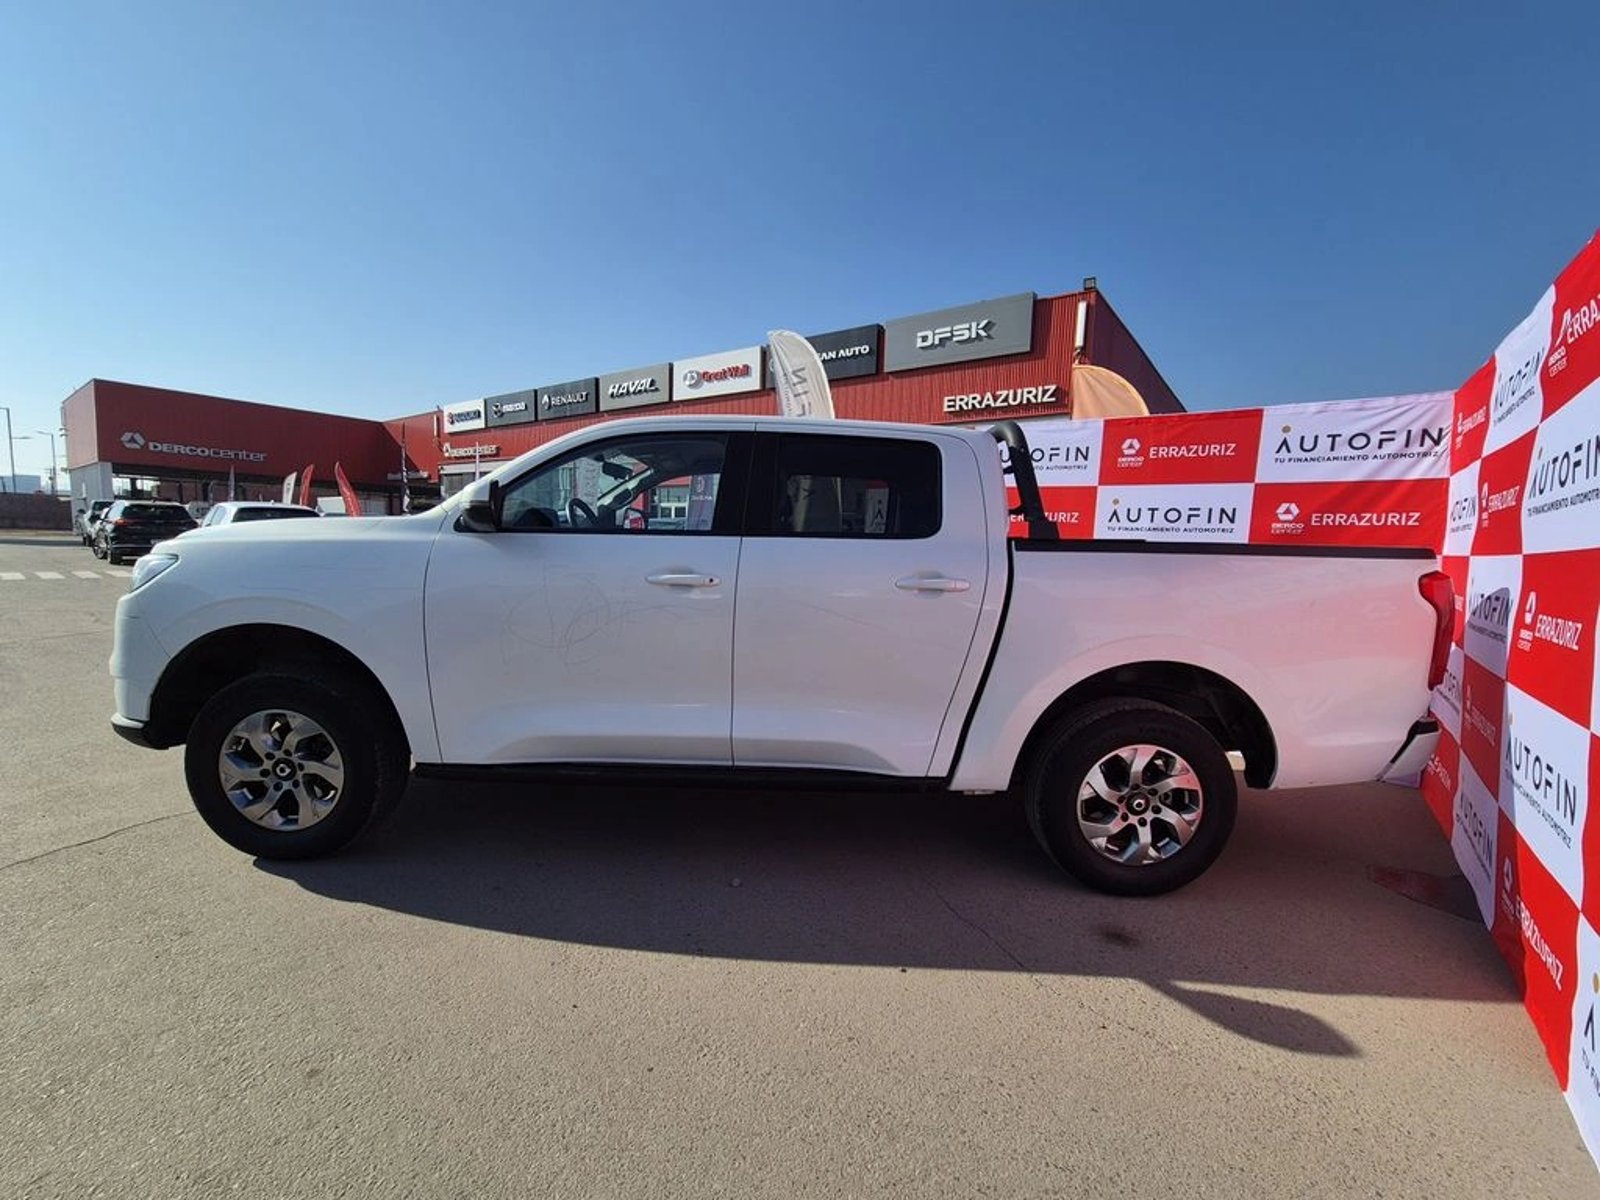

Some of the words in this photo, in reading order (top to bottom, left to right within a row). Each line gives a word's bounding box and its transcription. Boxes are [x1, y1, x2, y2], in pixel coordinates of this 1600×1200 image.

[916, 320, 990, 347] DFSK
[838, 345, 870, 357] AUTO
[608, 378, 656, 397] HAVAL
[551, 391, 588, 406] RENAULT
[943, 385, 1057, 411] ERRAZURIZ
[1275, 425, 1443, 454] AUTOFIN
[1149, 443, 1237, 459] ERRAZURIZ
[1288, 455, 1369, 463] FINANCIAMIENTO
[1108, 499, 1236, 524] AUTOFIN
[1311, 512, 1421, 526] ERRAZURIZ
[1505, 736, 1576, 826] AUTOFIN
